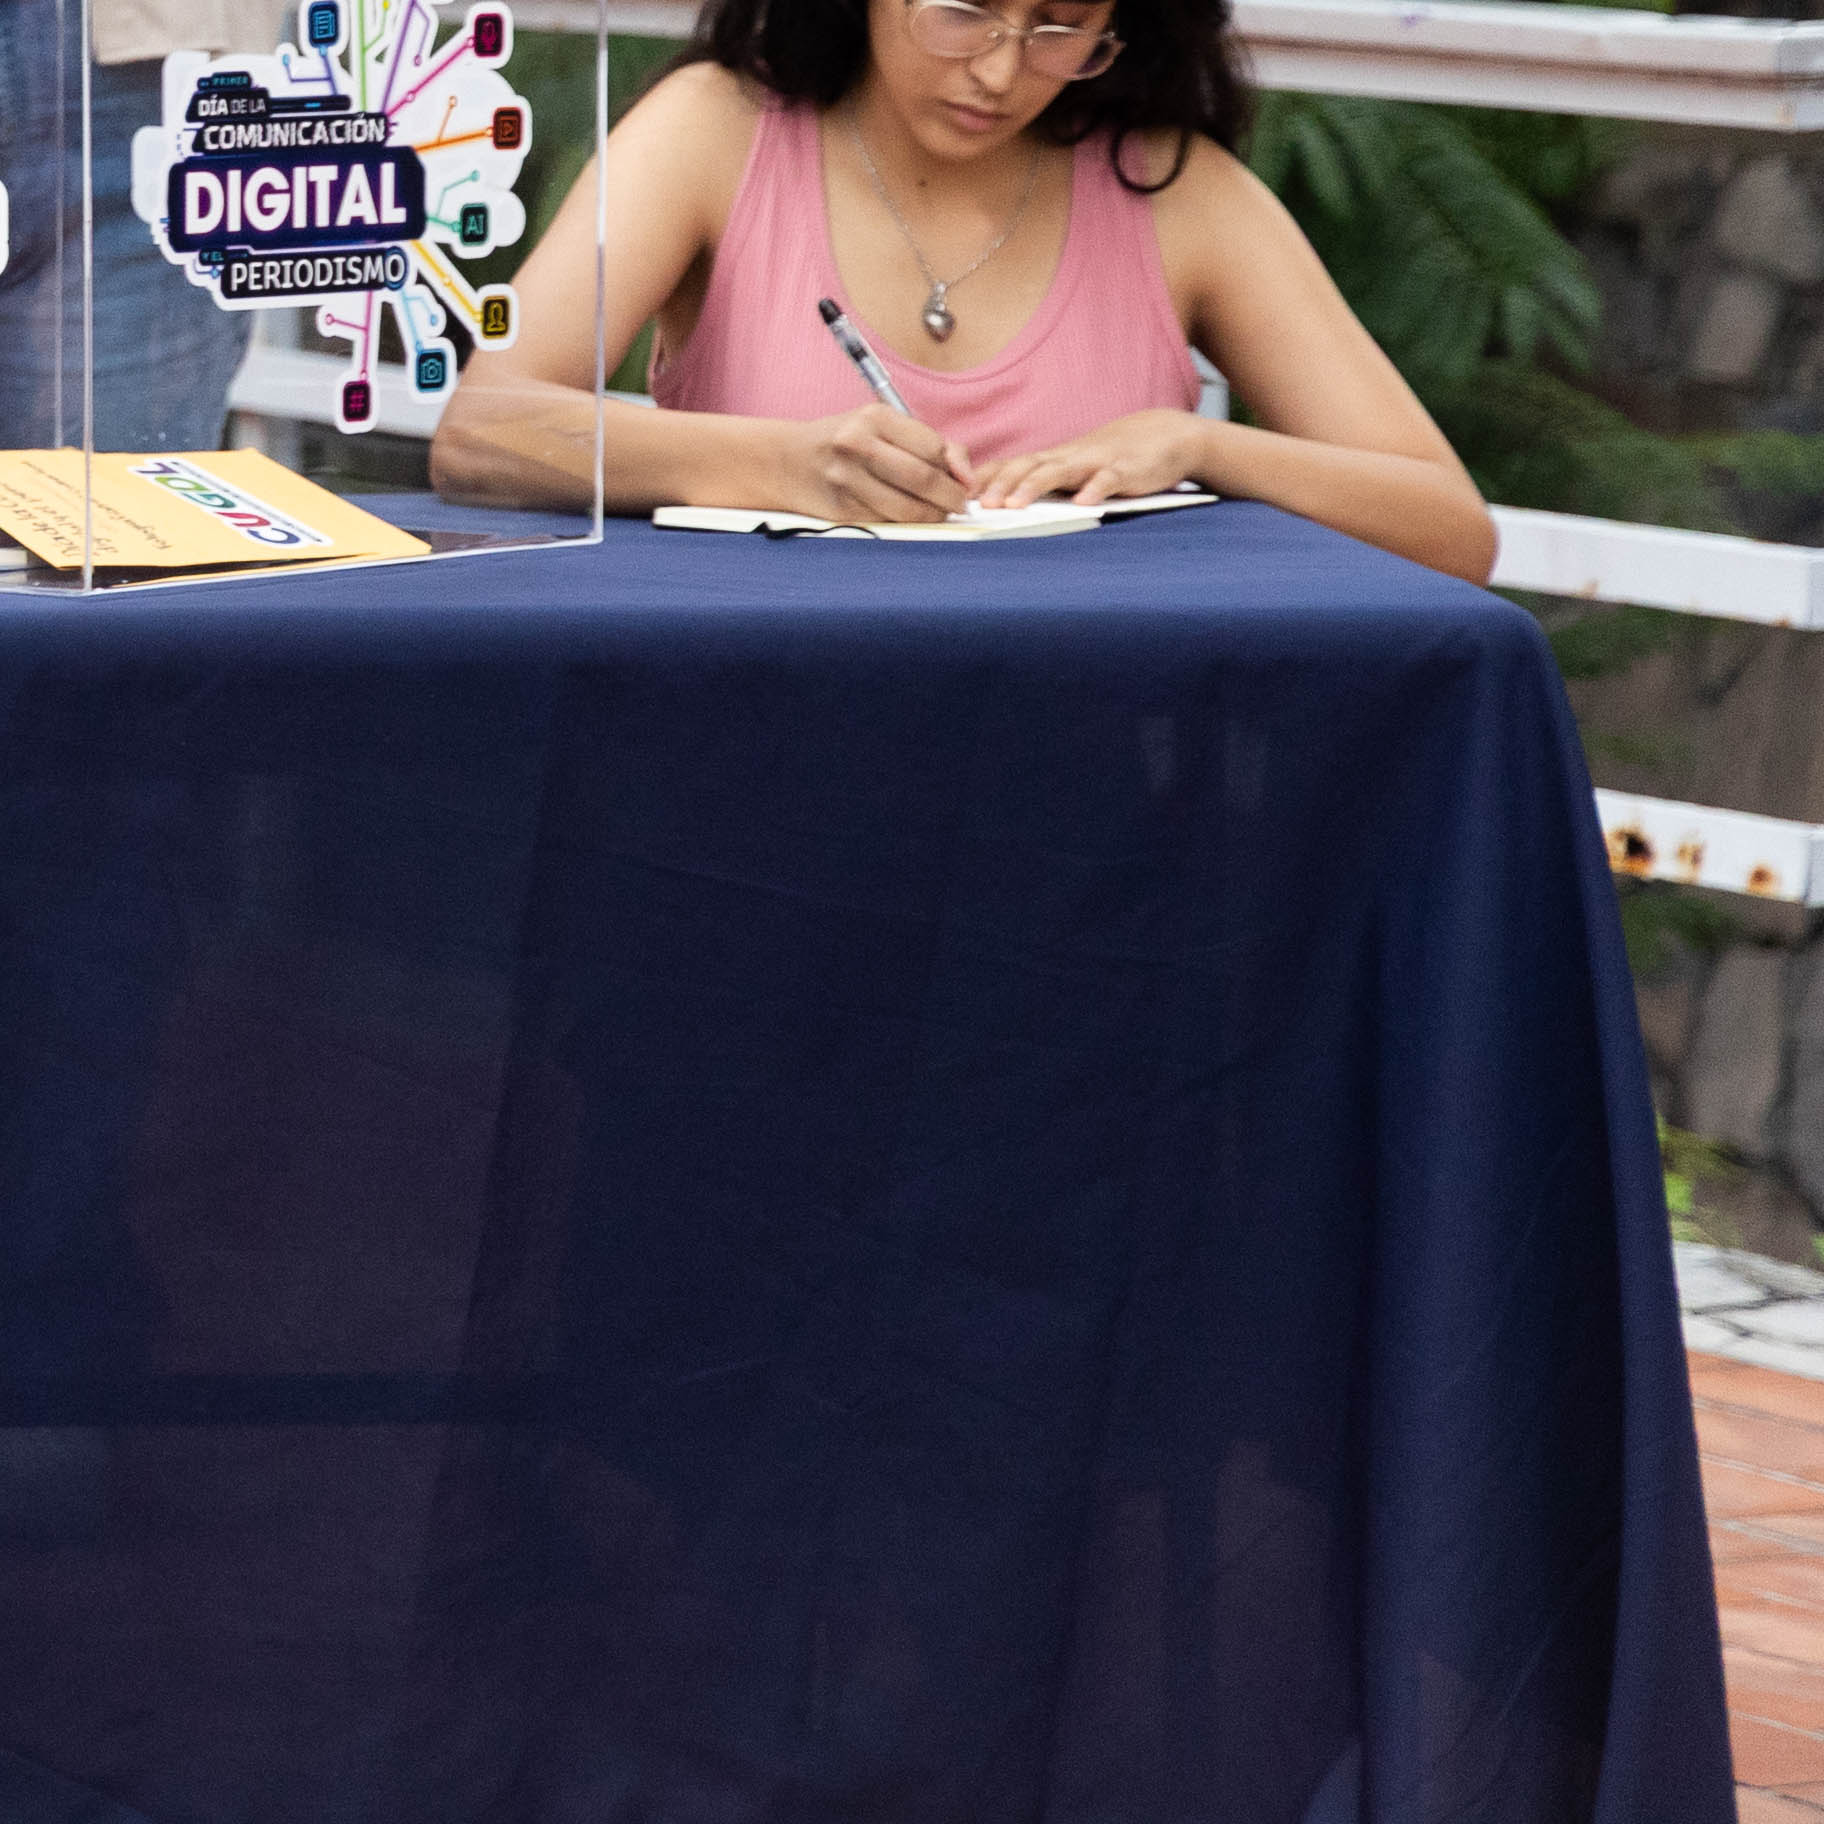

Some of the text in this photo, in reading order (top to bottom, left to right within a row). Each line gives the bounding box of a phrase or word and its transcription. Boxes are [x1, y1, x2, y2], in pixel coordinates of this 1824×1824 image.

[197, 94, 267, 117] DÍA DE LA
[203, 111, 387, 151] COMUNICACIÓN
[184, 161, 408, 236] DIGITAL
[230, 253, 406, 293] PERIODISMO
[135, 460, 302, 545] CUGDL
